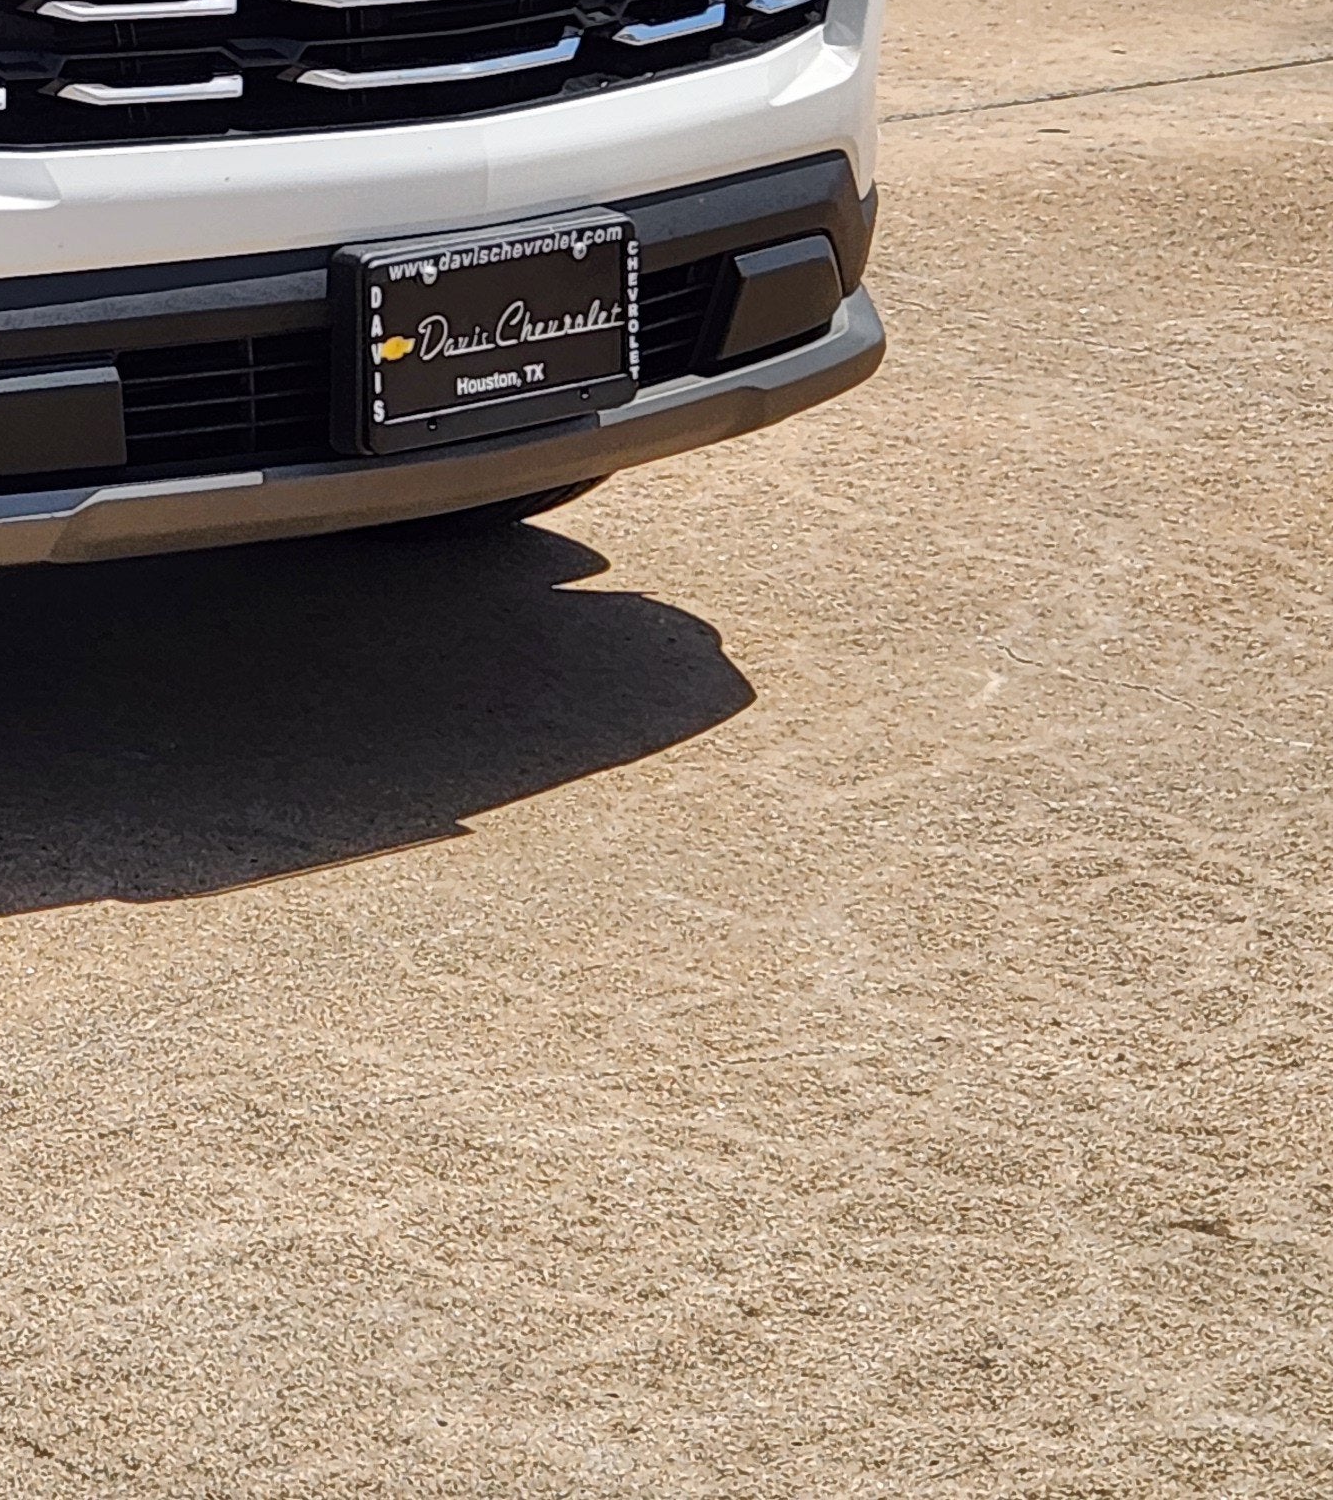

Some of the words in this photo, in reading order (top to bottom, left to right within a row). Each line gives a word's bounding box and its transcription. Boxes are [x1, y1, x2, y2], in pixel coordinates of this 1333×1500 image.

[388, 225, 623, 282] wwwdavischevroletcom
[418, 314, 497, 361] Davis
[495, 298, 626, 348] Chevrolet
[626, 240, 641, 381] CHEVROLET
[370, 286, 385, 423] DAVIS
[456, 371, 523, 396] Houston,
[523, 362, 546, 383] TX
